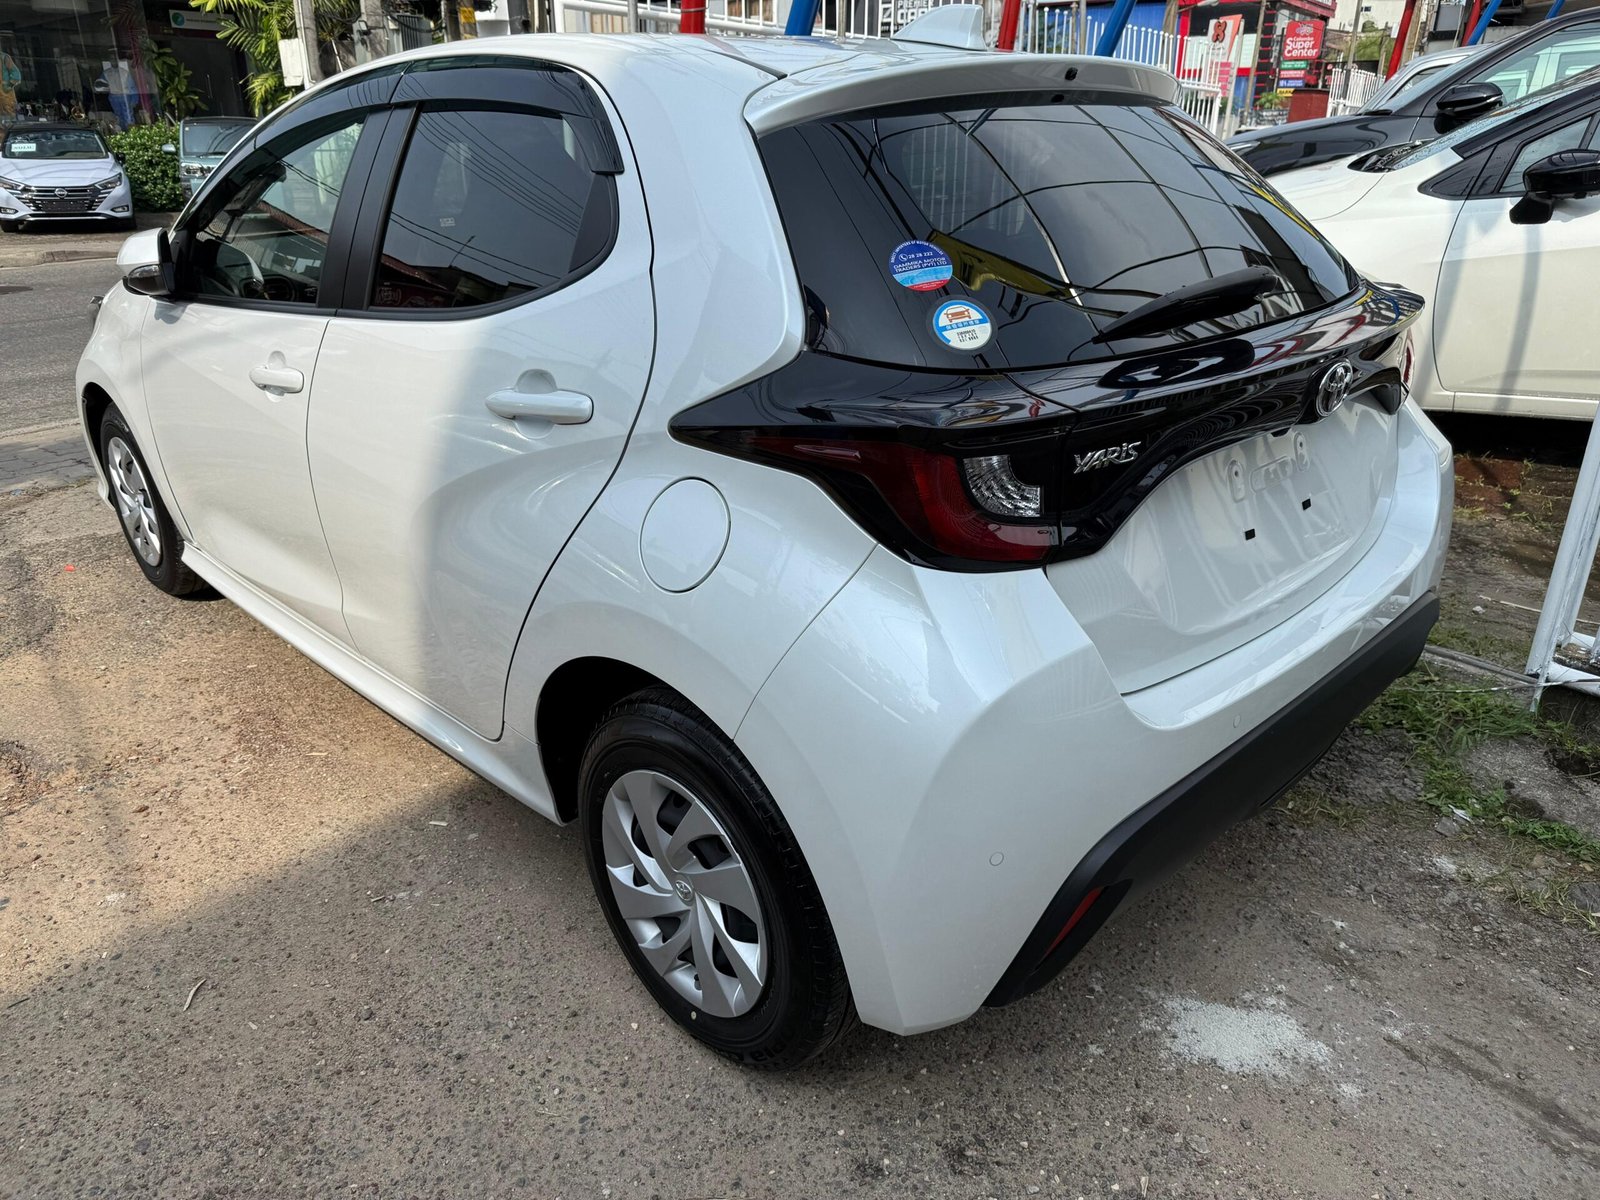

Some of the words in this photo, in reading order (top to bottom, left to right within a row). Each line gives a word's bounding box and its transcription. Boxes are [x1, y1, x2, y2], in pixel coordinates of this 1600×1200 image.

[1286, 37, 1315, 49] Super
[1284, 48, 1318, 57] Center
[893, 260, 923, 270] DAMMIKA
[895, 264, 921, 273] TRADERS
